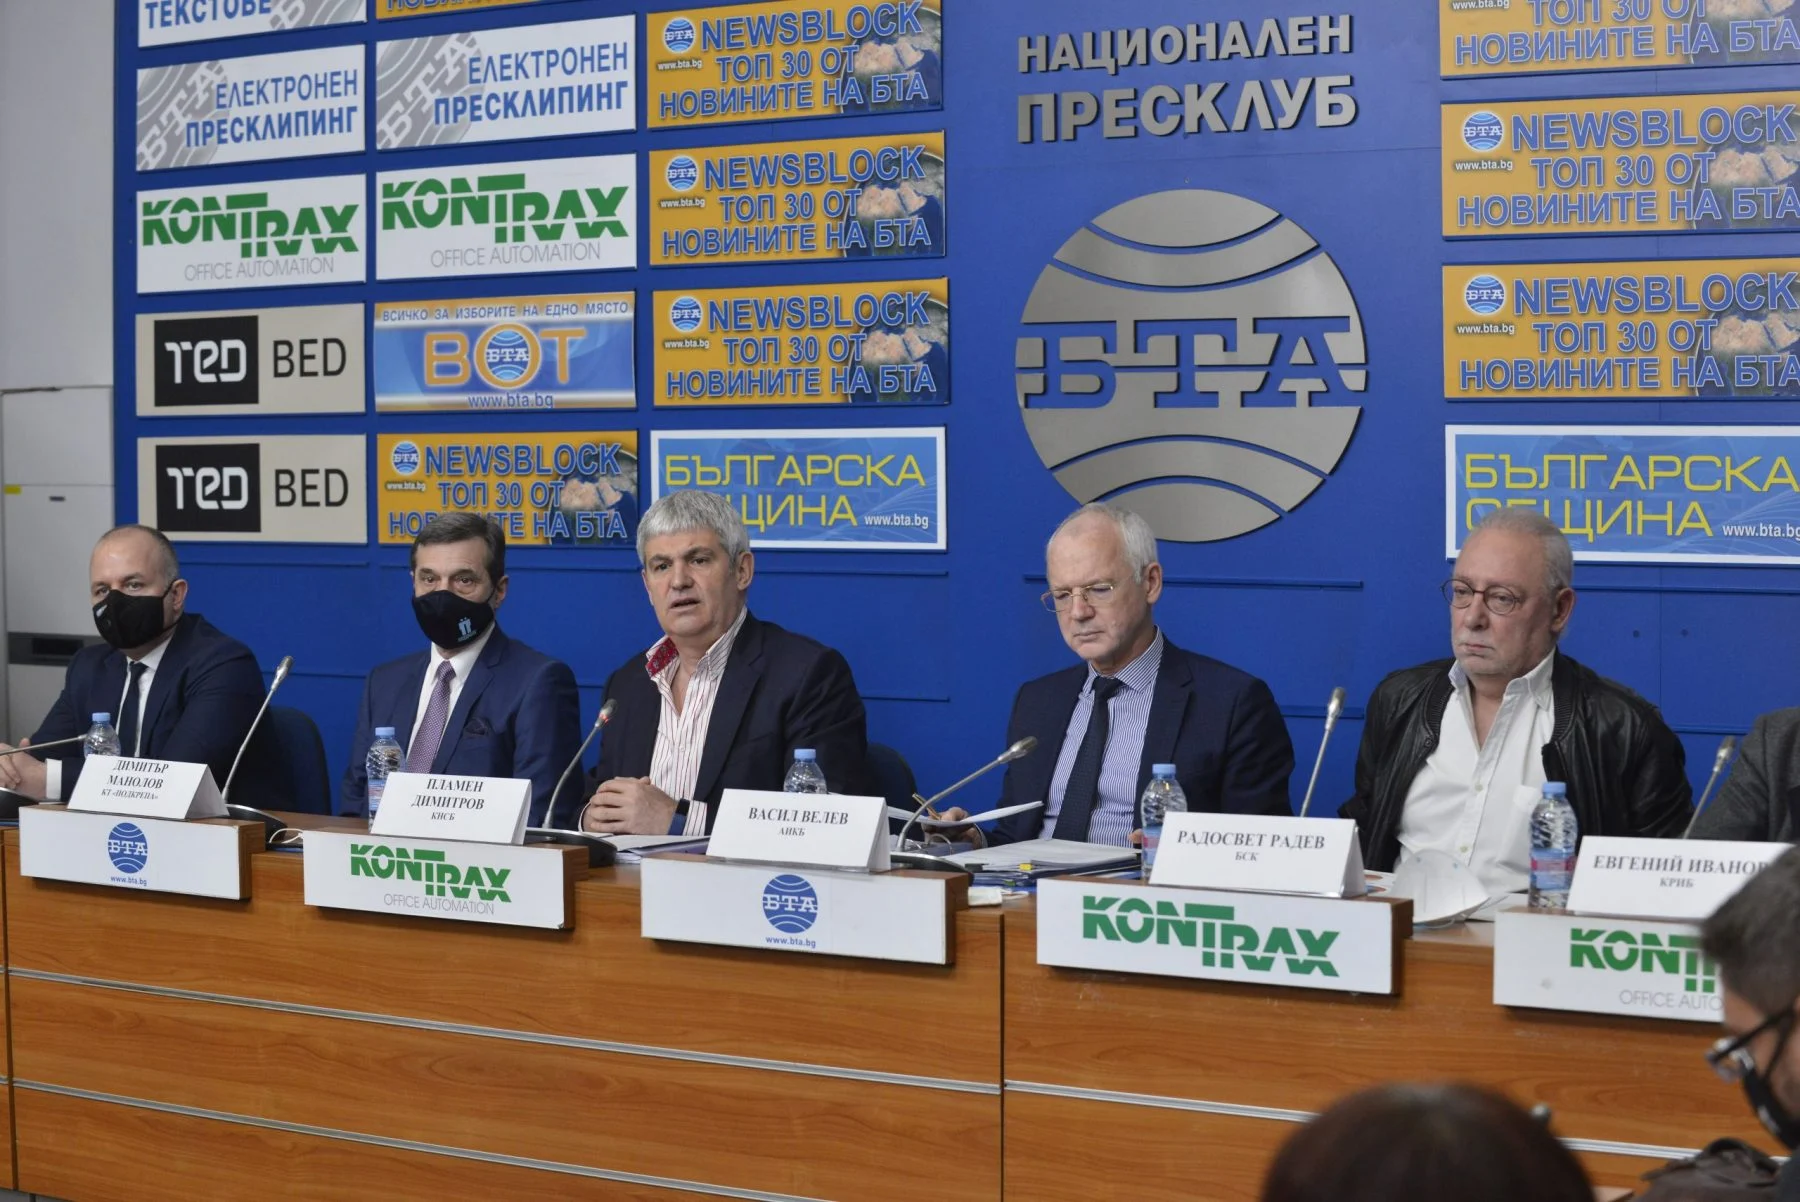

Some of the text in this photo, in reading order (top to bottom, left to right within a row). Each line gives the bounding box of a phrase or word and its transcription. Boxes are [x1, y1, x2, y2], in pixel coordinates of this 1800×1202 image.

[702, 1, 923, 50] NEWSBLOCK
[1455, 18, 1800, 66] НОВИНИТЕ НА БТА
[1018, 14, 1354, 75] НАЦИОНАЛЕН
[468, 41, 628, 85] ЕЛЕКТРОНЕН
[716, 45, 860, 83] ТОП 30 ОТ
[215, 69, 358, 109] ЕЛЕКТРОНЕН
[434, 81, 628, 125] ПРЕСКЛИПИНГ
[659, 72, 929, 119] НОВИНИТЕ НА БТА
[1018, 75, 1358, 143] ПРЕСКЛУБ
[186, 106, 358, 148] ПРЕСКЛИПИНГ
[1512, 104, 1797, 151] NEWSBLOCK
[704, 145, 926, 190] NEWSBLOCK
[1455, 160, 1513, 171] www.bta.bg
[1530, 152, 1716, 188] ТОП 30 ОТ
[382, 173, 629, 244] KONTRAX
[719, 189, 863, 223] ТОП 30 ОТ
[1457, 186, 1800, 226] НОВИНИТЕ НА БТА
[142, 192, 359, 258] KONTRAX
[662, 218, 931, 257] НОВИНИТЕ НА БТА
[184, 257, 334, 281] OFFICE AUTOMATION
[430, 241, 600, 268] OFFICE AUTOMATION
[1513, 272, 1800, 315] NEWSBLOCK
[383, 302, 629, 321] ВСИЧКО ЗА ИЗБОРИТЕ НА ЕДНО МЯСТО
[709, 291, 930, 331] NEWSBLOCK
[1457, 323, 1515, 335] www.bta.bg
[1532, 319, 1718, 353] ТОП 30 ОТ
[273, 338, 346, 378] BED
[722, 333, 867, 364] ТОП 30 ОТ
[1018, 315, 1352, 409] БТА
[666, 364, 937, 397] НОВИНИТЕ НА БТА
[1460, 355, 1800, 389] НОВИНИТЕ НА БТА
[467, 393, 554, 408] www.bta.bg
[424, 443, 622, 476] NEWSBLOCK
[665, 454, 926, 487] БЪЛГАРСКА
[1465, 454, 1800, 492] БЪЛГАРСКА
[275, 468, 349, 507] BED
[437, 481, 565, 507] ТОП 30 ОТ
[532, 511, 569, 538] НА
[575, 511, 628, 538] БТА
[726, 494, 858, 532] ЩИНА
[864, 512, 929, 529] www.bta.bg
[107, 775, 163, 789] МАНОЛОВ
[427, 778, 483, 792] ПЛАМЕН
[411, 795, 485, 809] ДИМИТРОВ
[748, 807, 849, 825] ВАСИЛ ВЕЛЕВ
[108, 839, 148, 856] БТА
[1177, 830, 1325, 849] РАДОСВЕТ РАДЕВ
[1235, 851, 1259, 861] БСК
[110, 875, 147, 886] www.bta.bg
[351, 843, 511, 903] KONTRAX
[1593, 855, 1683, 873] ЕВГЕНИЙ
[384, 894, 494, 915] OFFICE AUTOMATION
[763, 894, 818, 913] БТА
[765, 935, 816, 949] www.bta.bg
[1082, 895, 1340, 978] KONTRAX
[1619, 989, 1674, 1008] OFFICE
